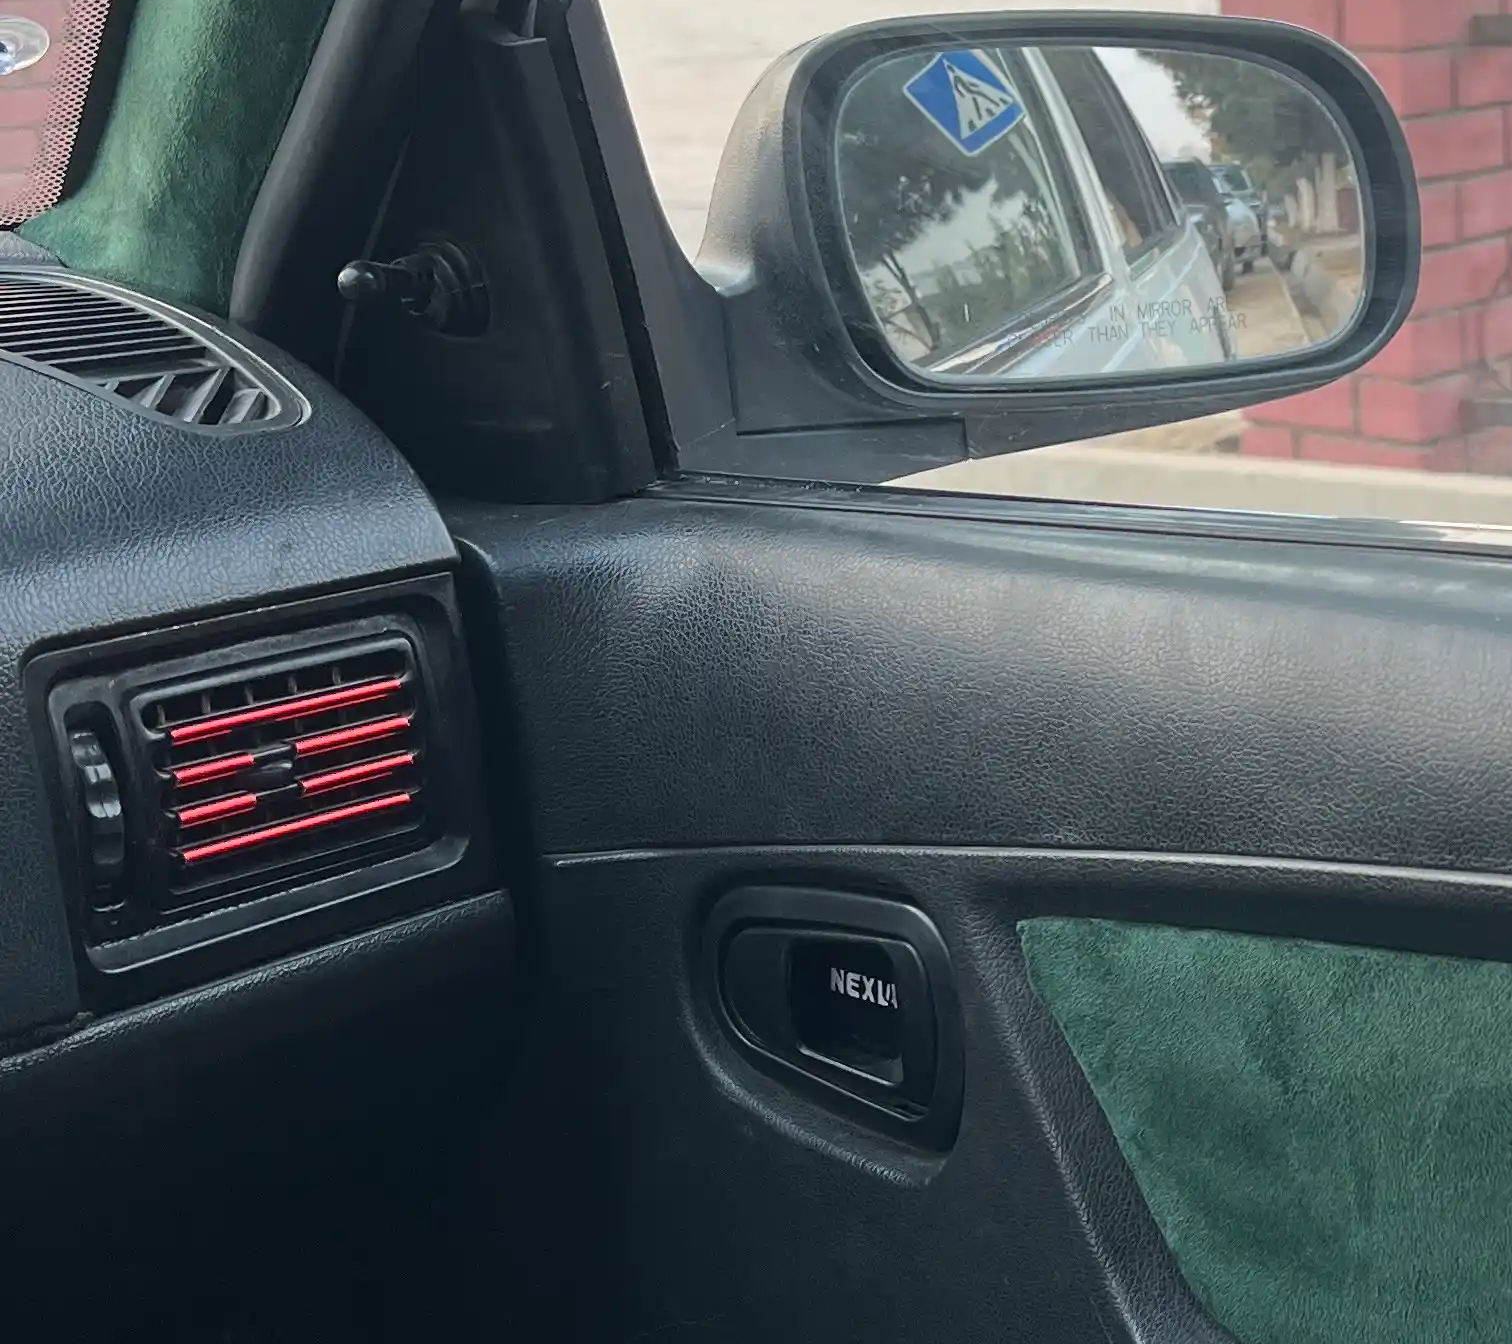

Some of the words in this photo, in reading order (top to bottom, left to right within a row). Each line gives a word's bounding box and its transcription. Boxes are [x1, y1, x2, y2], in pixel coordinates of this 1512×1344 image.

[1109, 303, 1126, 322] IN
[1137, 298, 1192, 320] MIRROR
[1088, 323, 1129, 343] THAN
[1141, 319, 1179, 339] THEY
[1190, 311, 1247, 335] APPEAR
